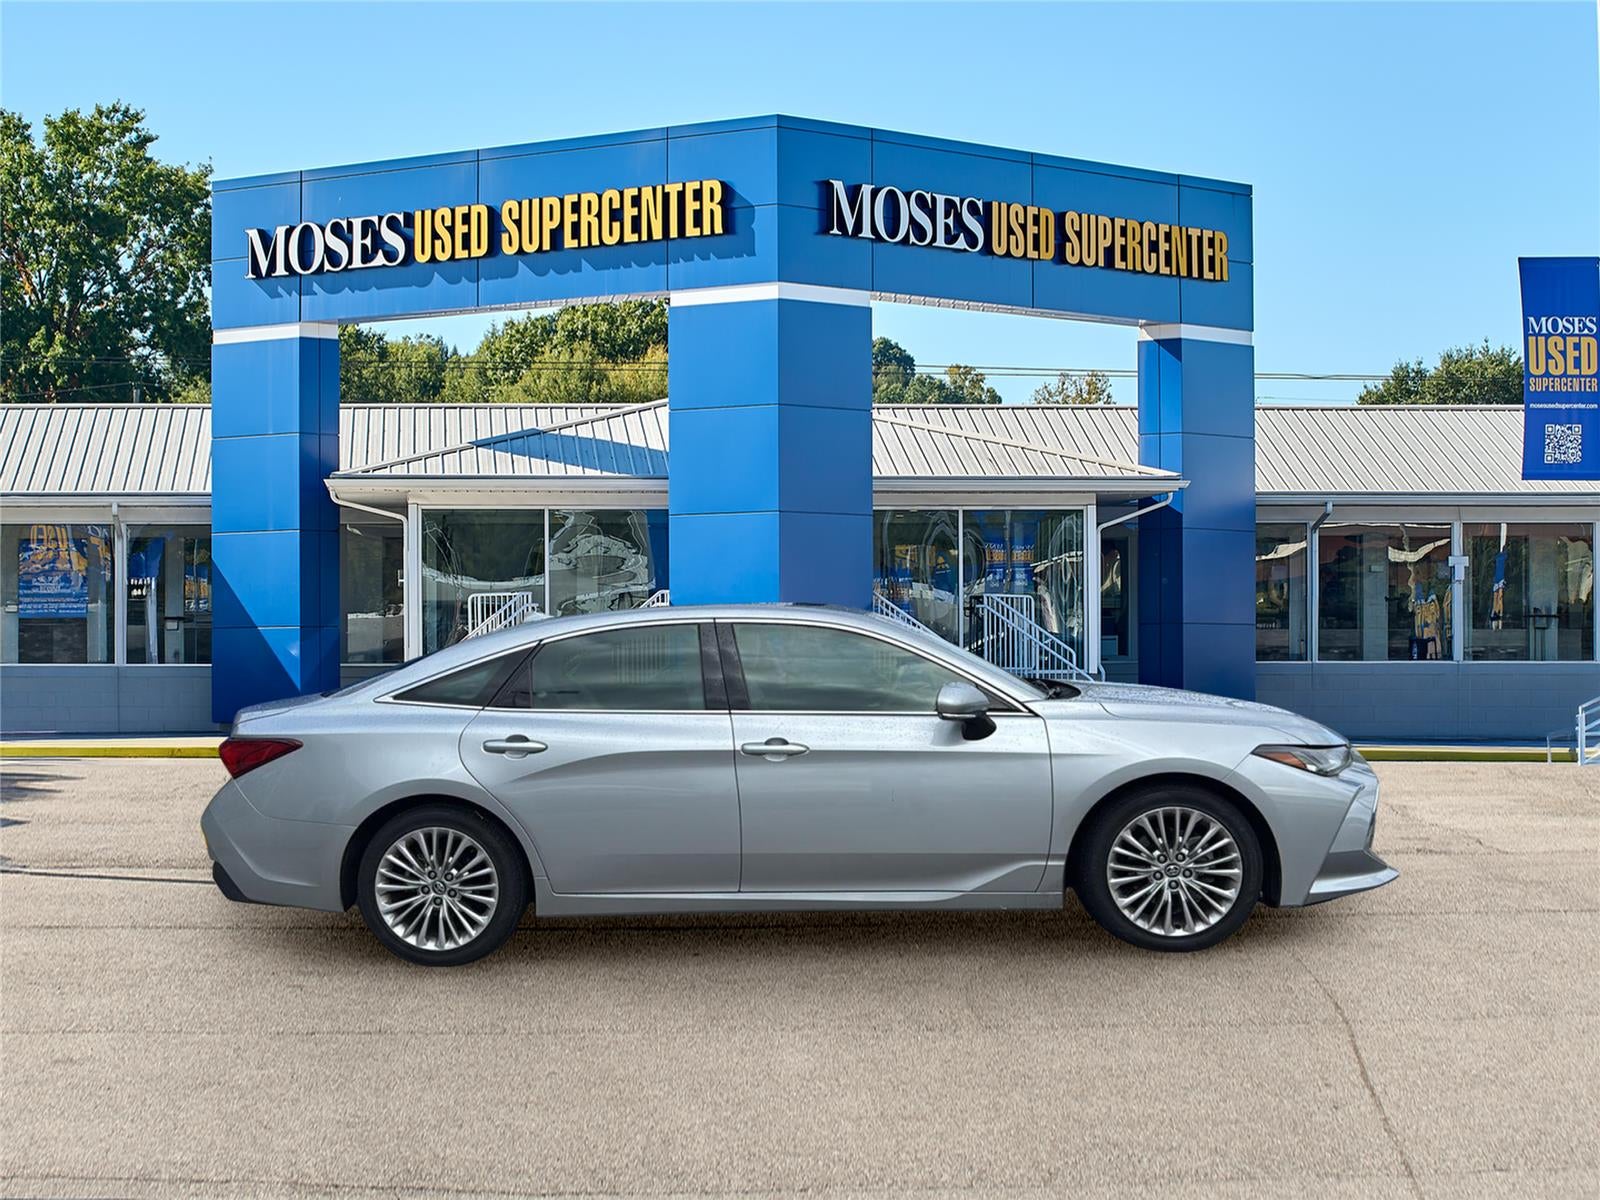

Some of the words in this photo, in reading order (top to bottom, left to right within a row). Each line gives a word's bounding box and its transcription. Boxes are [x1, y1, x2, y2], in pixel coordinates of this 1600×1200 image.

[244, 212, 406, 280] MOSES
[413, 204, 489, 265] USED
[501, 178, 724, 257] SUPERCENTER
[828, 179, 985, 253] MOSES
[990, 200, 1056, 262] USED
[1064, 211, 1230, 282] SUPERCENTER
[1527, 316, 1597, 335] MOSES
[1528, 336, 1598, 376] USED
[1529, 377, 1598, 392] SUPERCENTER
